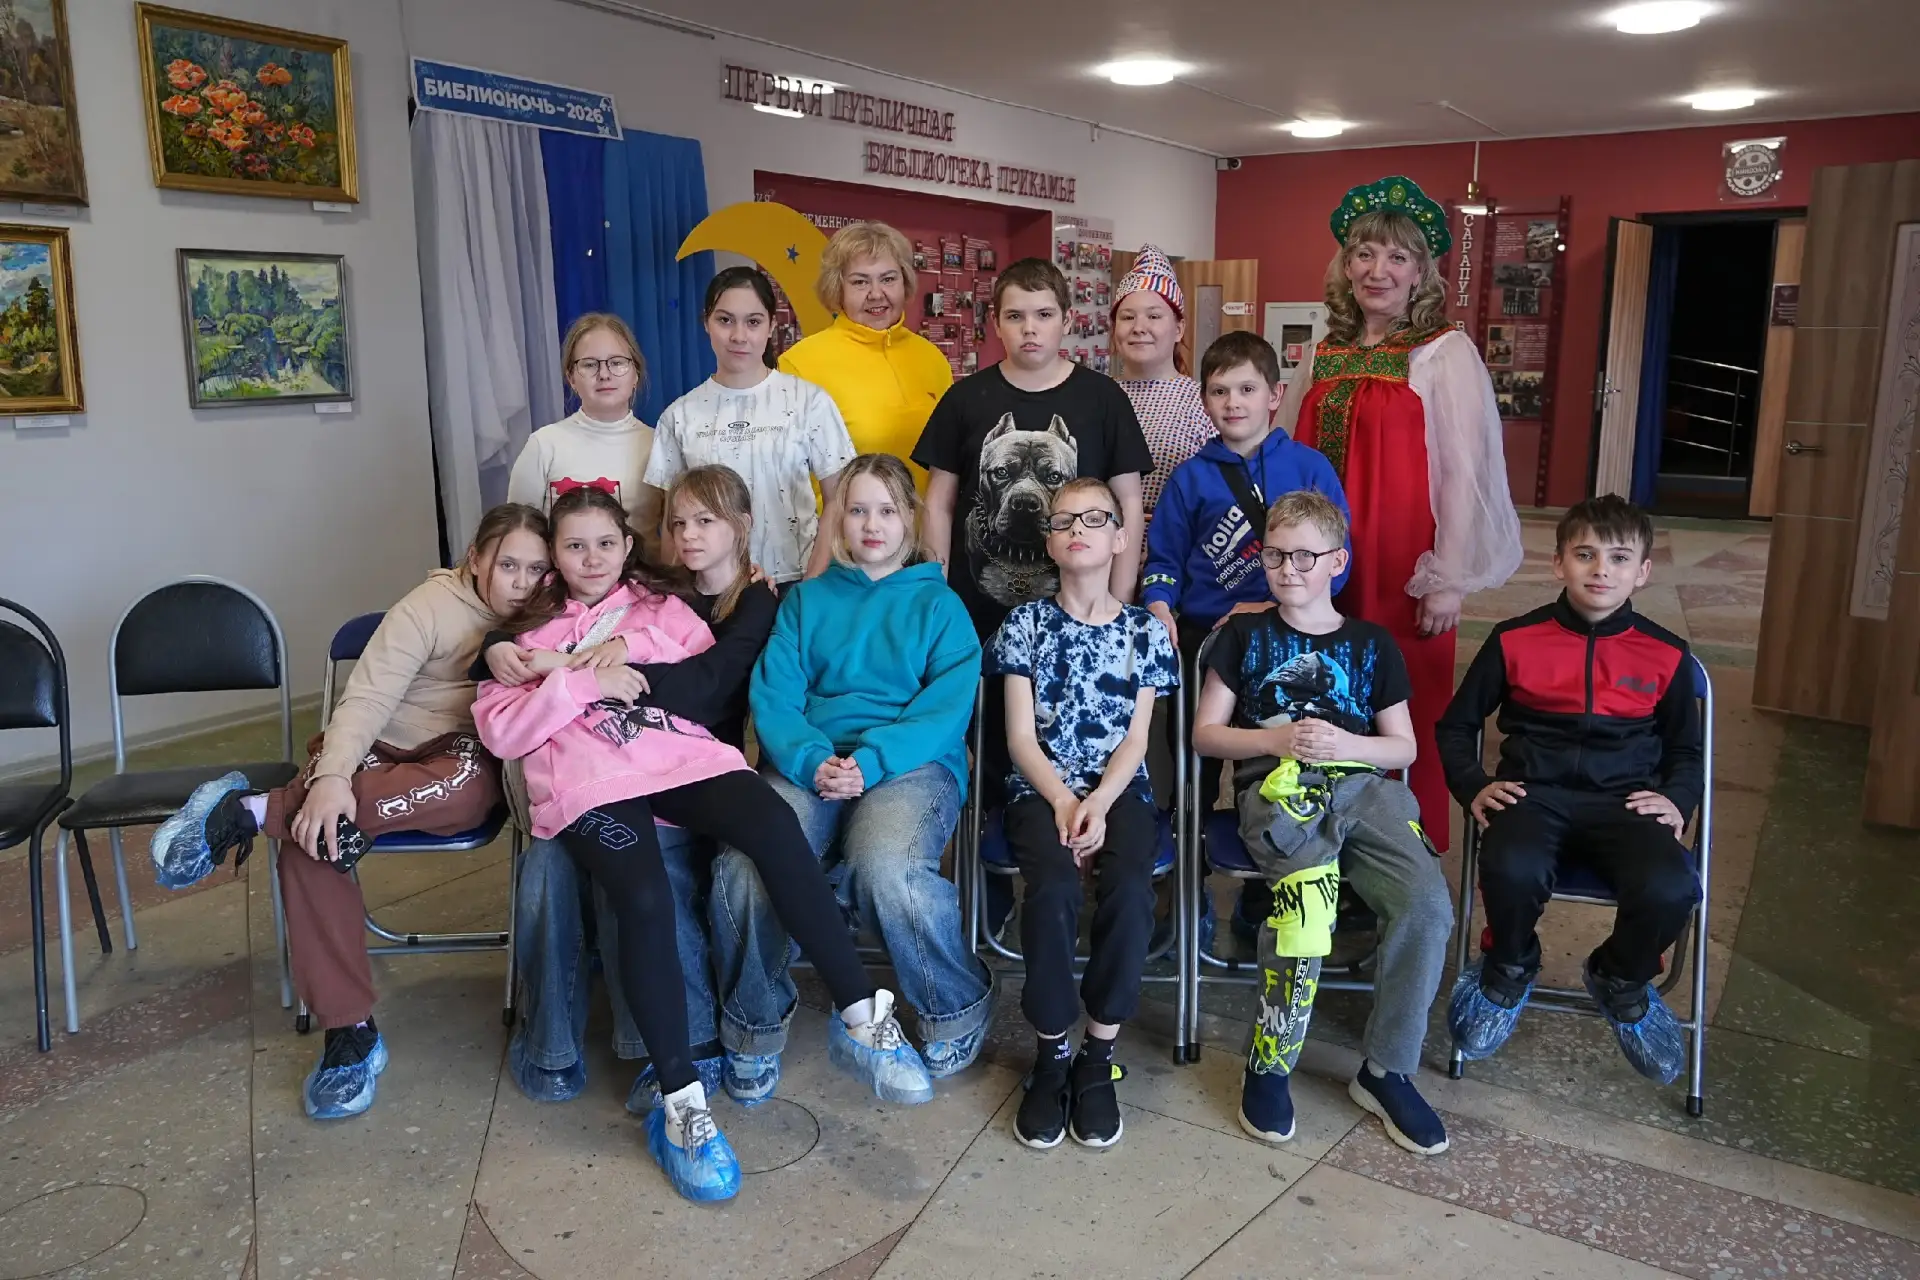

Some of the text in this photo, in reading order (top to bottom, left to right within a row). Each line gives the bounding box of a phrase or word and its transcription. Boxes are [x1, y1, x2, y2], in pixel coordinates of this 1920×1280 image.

[724, 64, 955, 142] ПЕРВАЯ ПУБЛИЧНАЯ
[865, 141, 1077, 203] БИБЛИОТЕКА ПРИКАМЬЯ
[1456, 214, 1475, 307] САРАПУЛ
[1212, 551, 1235, 569] here
[1215, 556, 1246, 584] getting
[1223, 557, 1262, 591] reaching
